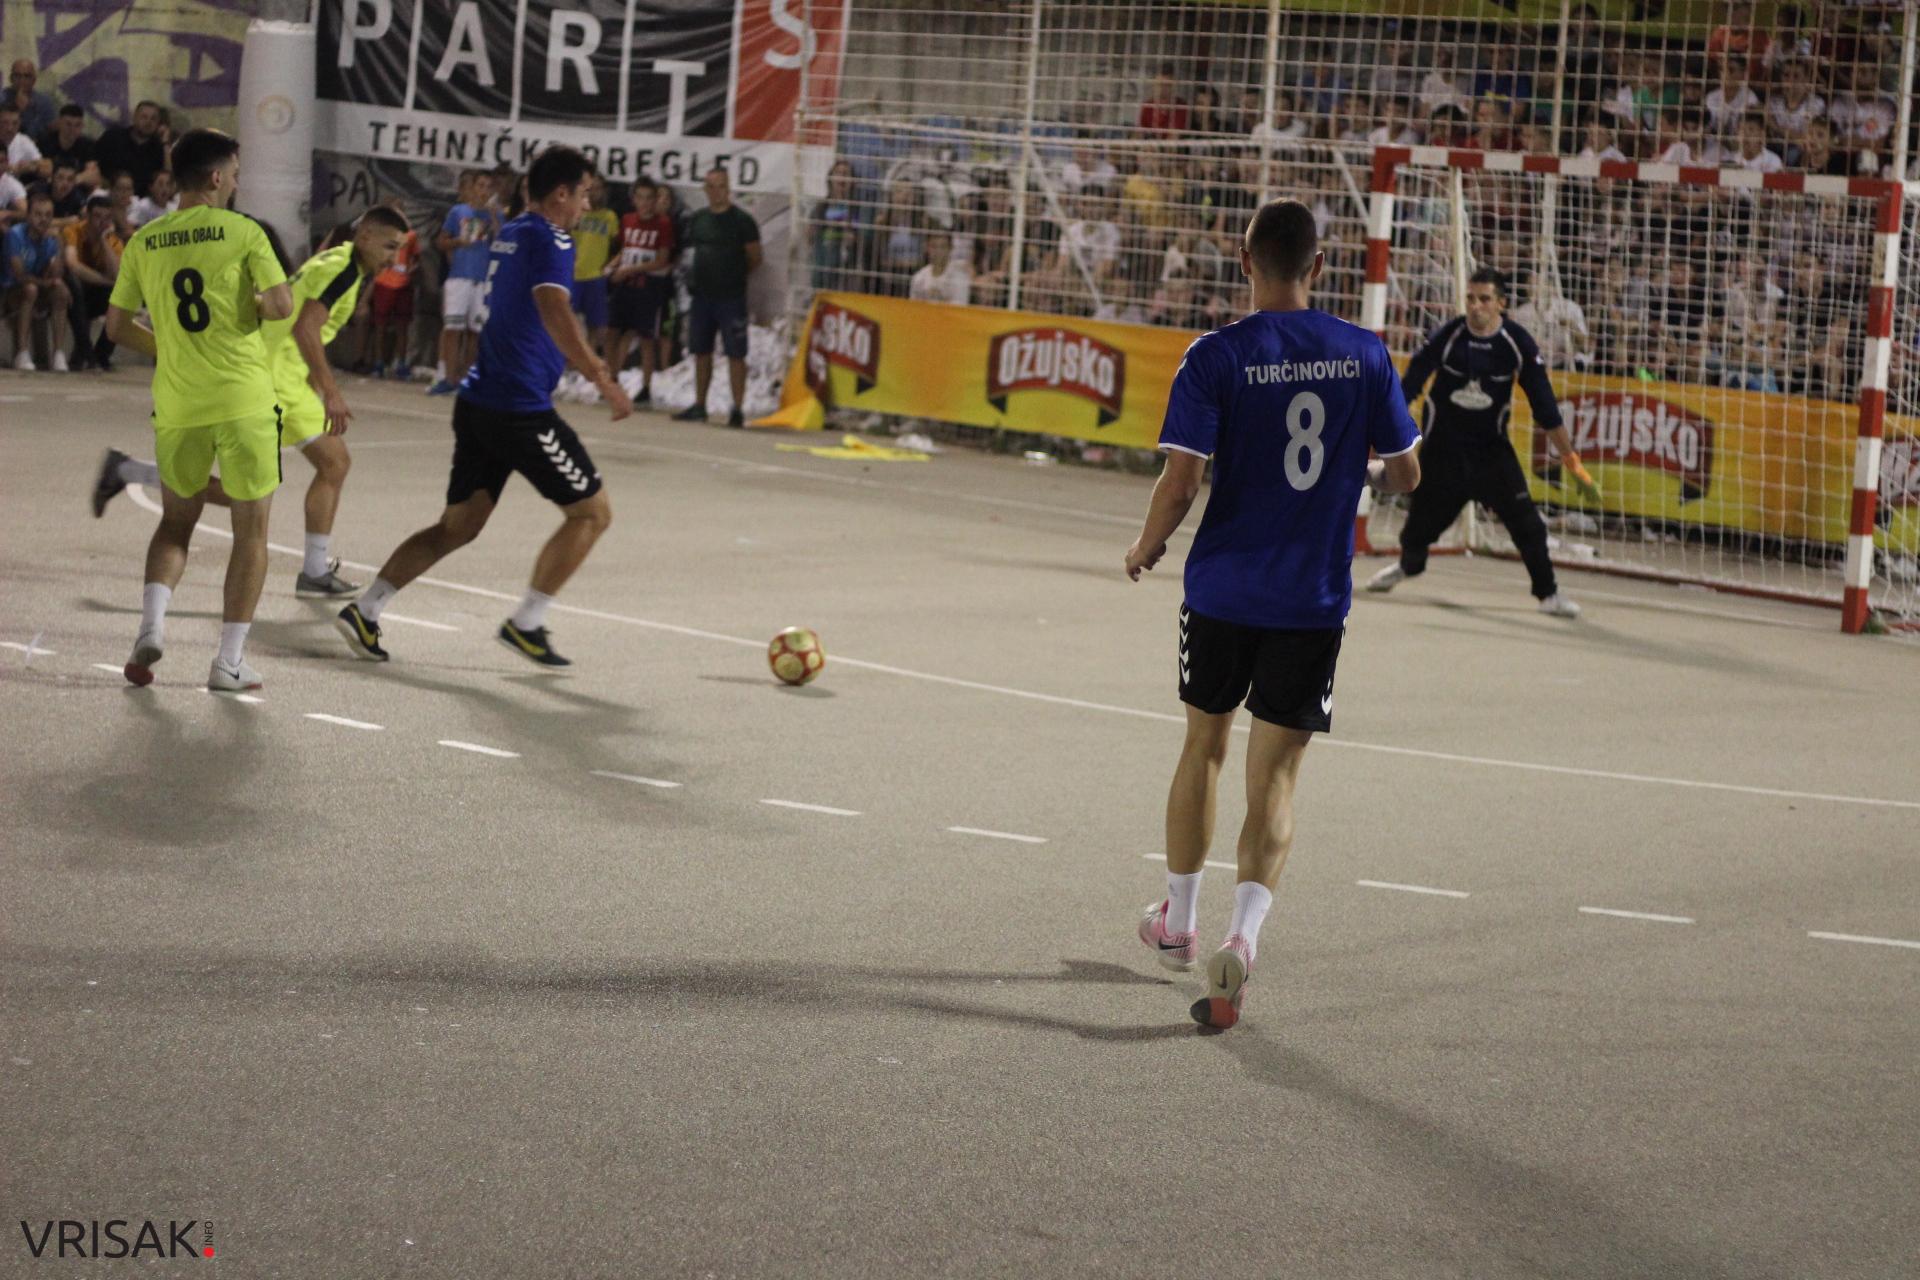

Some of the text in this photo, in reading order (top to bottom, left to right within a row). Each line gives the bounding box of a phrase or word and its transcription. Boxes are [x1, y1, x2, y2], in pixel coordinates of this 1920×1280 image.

[369, 121, 556, 168] TEHNIČK
[145, 234, 158, 251] MZ
[192, 226, 225, 244] OBALA
[172, 267, 211, 333] 8
[999, 332, 1115, 397] Ožujsko
[1245, 355, 1361, 385] TURČINOVIĆI
[1284, 391, 1325, 491] 8
